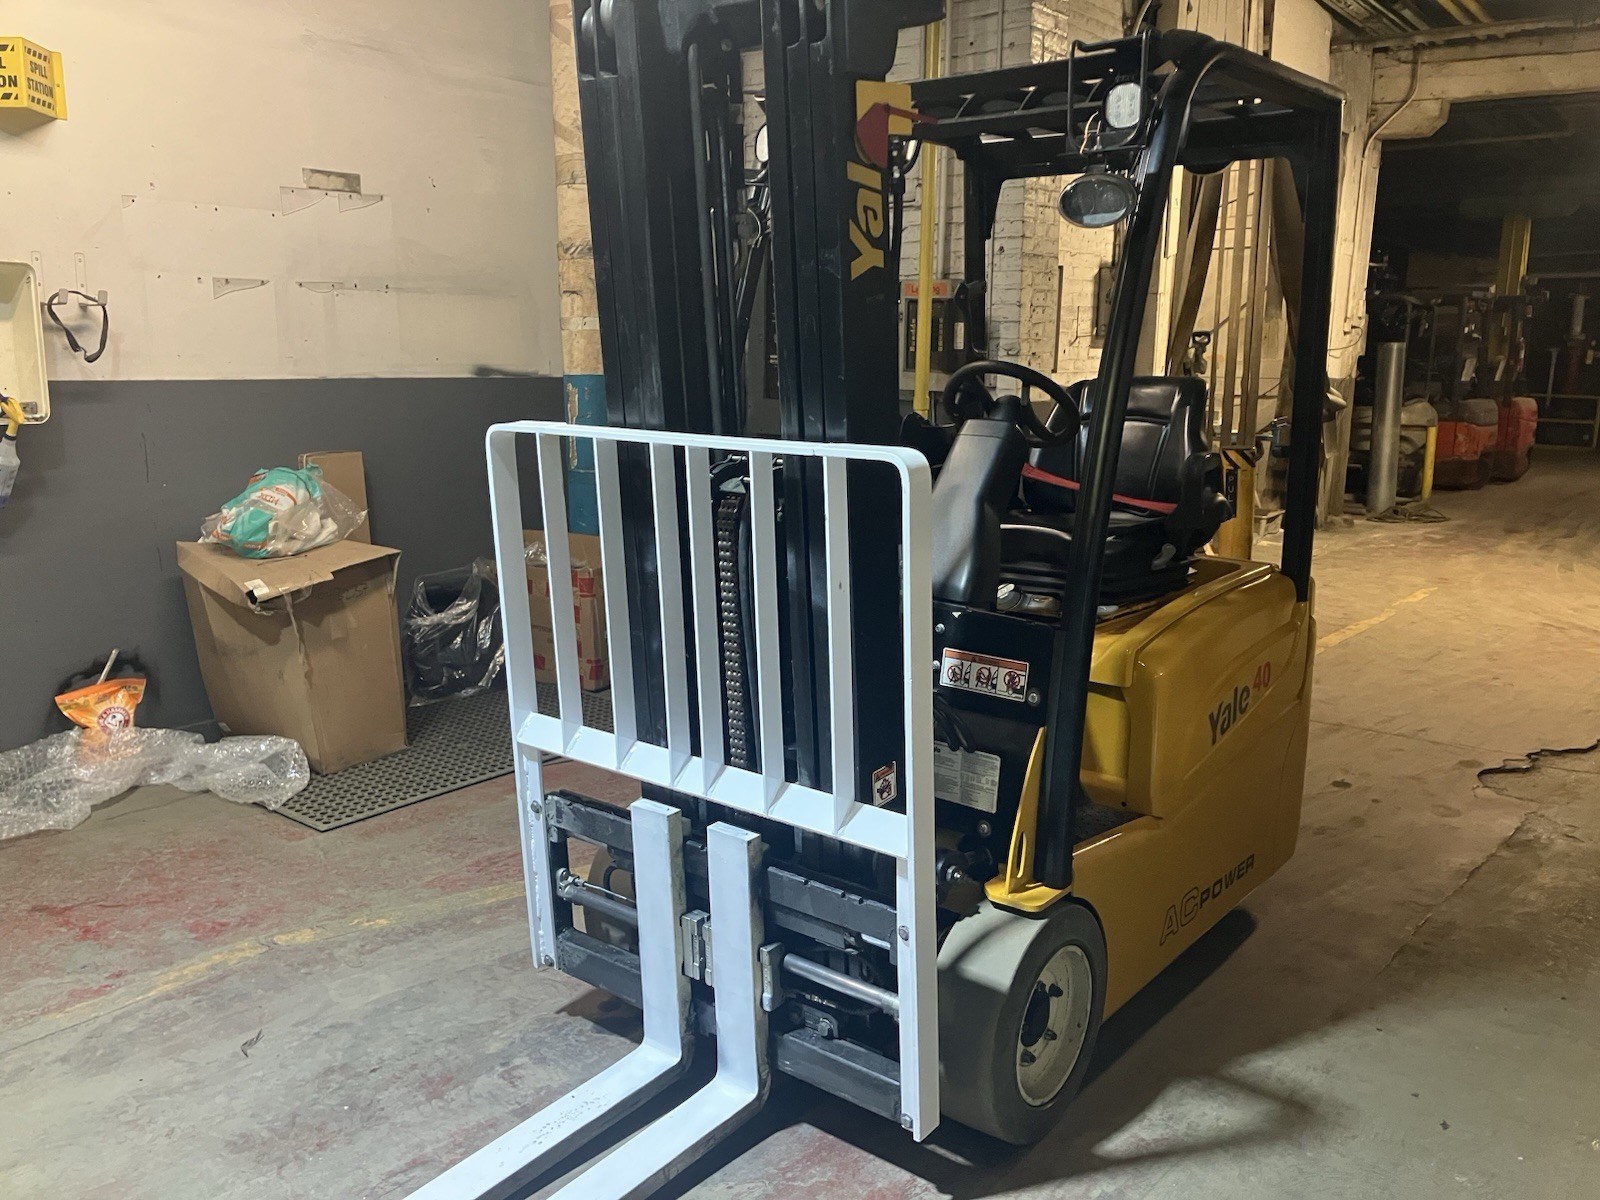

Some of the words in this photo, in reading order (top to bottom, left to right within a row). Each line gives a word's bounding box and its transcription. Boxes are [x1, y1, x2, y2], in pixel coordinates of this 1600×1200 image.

[26, 77, 54, 98] STATION
[29, 60, 48, 79] SPILL
[846, 152, 885, 281] Yal
[1208, 685, 1251, 746] Yale
[1253, 661, 1271, 691] 40
[1160, 886, 1200, 947] AC
[1200, 853, 1255, 910] POWER
